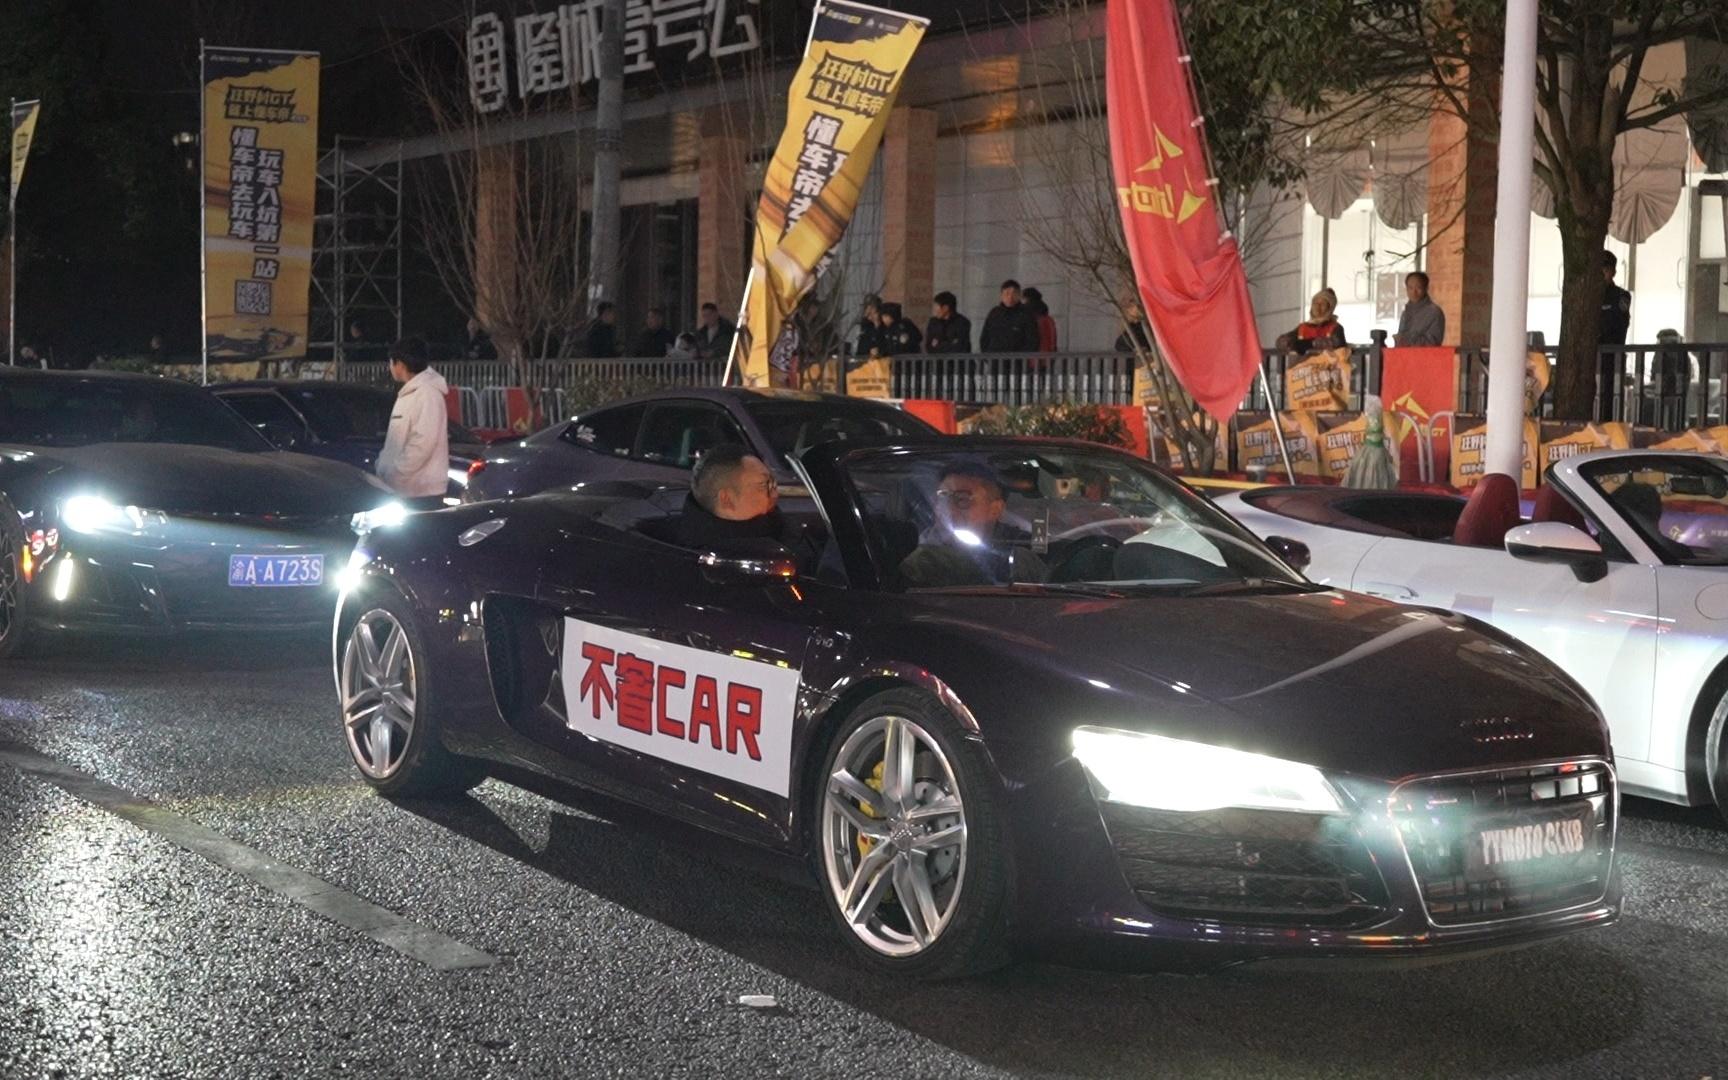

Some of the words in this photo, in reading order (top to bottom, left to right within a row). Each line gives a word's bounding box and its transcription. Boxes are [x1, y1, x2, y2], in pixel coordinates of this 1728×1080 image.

[231, 128, 257, 238] 懂车帝去玩车
[255, 150, 281, 279] 玩车入坑第一站
[1544, 819, 1584, 855] CLUB
